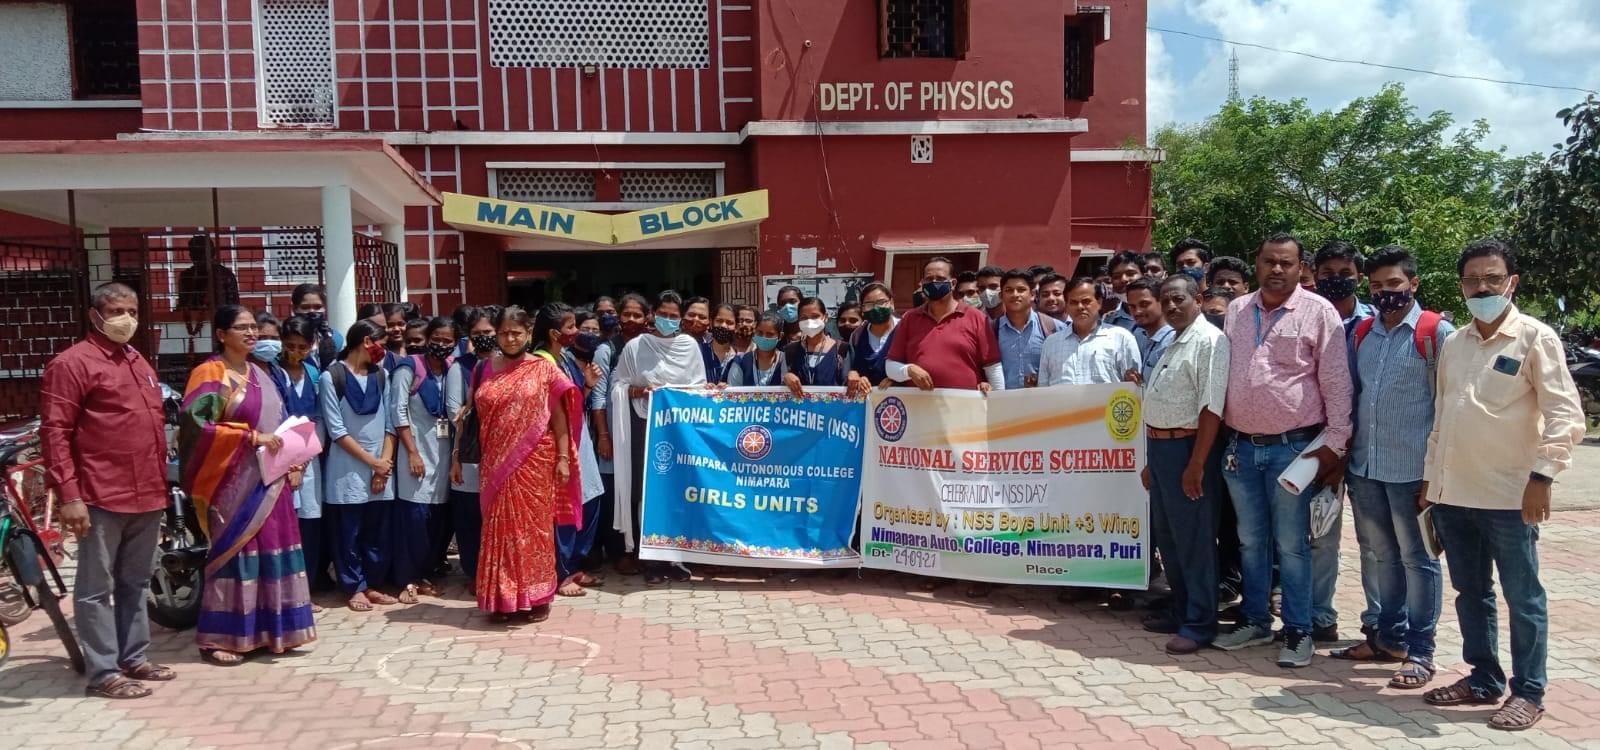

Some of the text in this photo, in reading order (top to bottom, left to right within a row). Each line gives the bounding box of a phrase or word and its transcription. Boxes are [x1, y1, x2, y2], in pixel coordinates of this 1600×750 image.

[820, 80, 1014, 111] DEPT. OF PHYSICS
[477, 198, 744, 235] MAIN BLOCK
[655, 407, 715, 428] NATIONAL
[719, 406, 770, 423] SERVICE
[774, 407, 825, 432] SCHEME
[828, 417, 860, 448] (NSS)
[676, 453, 854, 479] NIMAPARA AUTONOMOUS COLLEGE
[879, 445, 1136, 473] NATIONAL SERVICE SCHEME
[736, 477, 790, 489] NIMAPARA
[941, 483, 994, 505] CELEBRATION
[1002, 483, 1024, 504] NSS
[1025, 483, 1048, 504] DAY
[684, 486, 819, 513] GIRLS UNITS
[874, 502, 932, 527] Organised
[935, 513, 949, 533] by
[962, 511, 995, 530] NSS
[999, 513, 1034, 533] Boys
[1040, 515, 1071, 533] Unit
[1075, 515, 1095, 533] +3
[1100, 515, 1140, 538] Wing
[871, 526, 1142, 561] Nimapara Auto. College, Nimapara, Puri
[871, 548, 891, 558] Dt-
[1026, 564, 1069, 575] Place-
